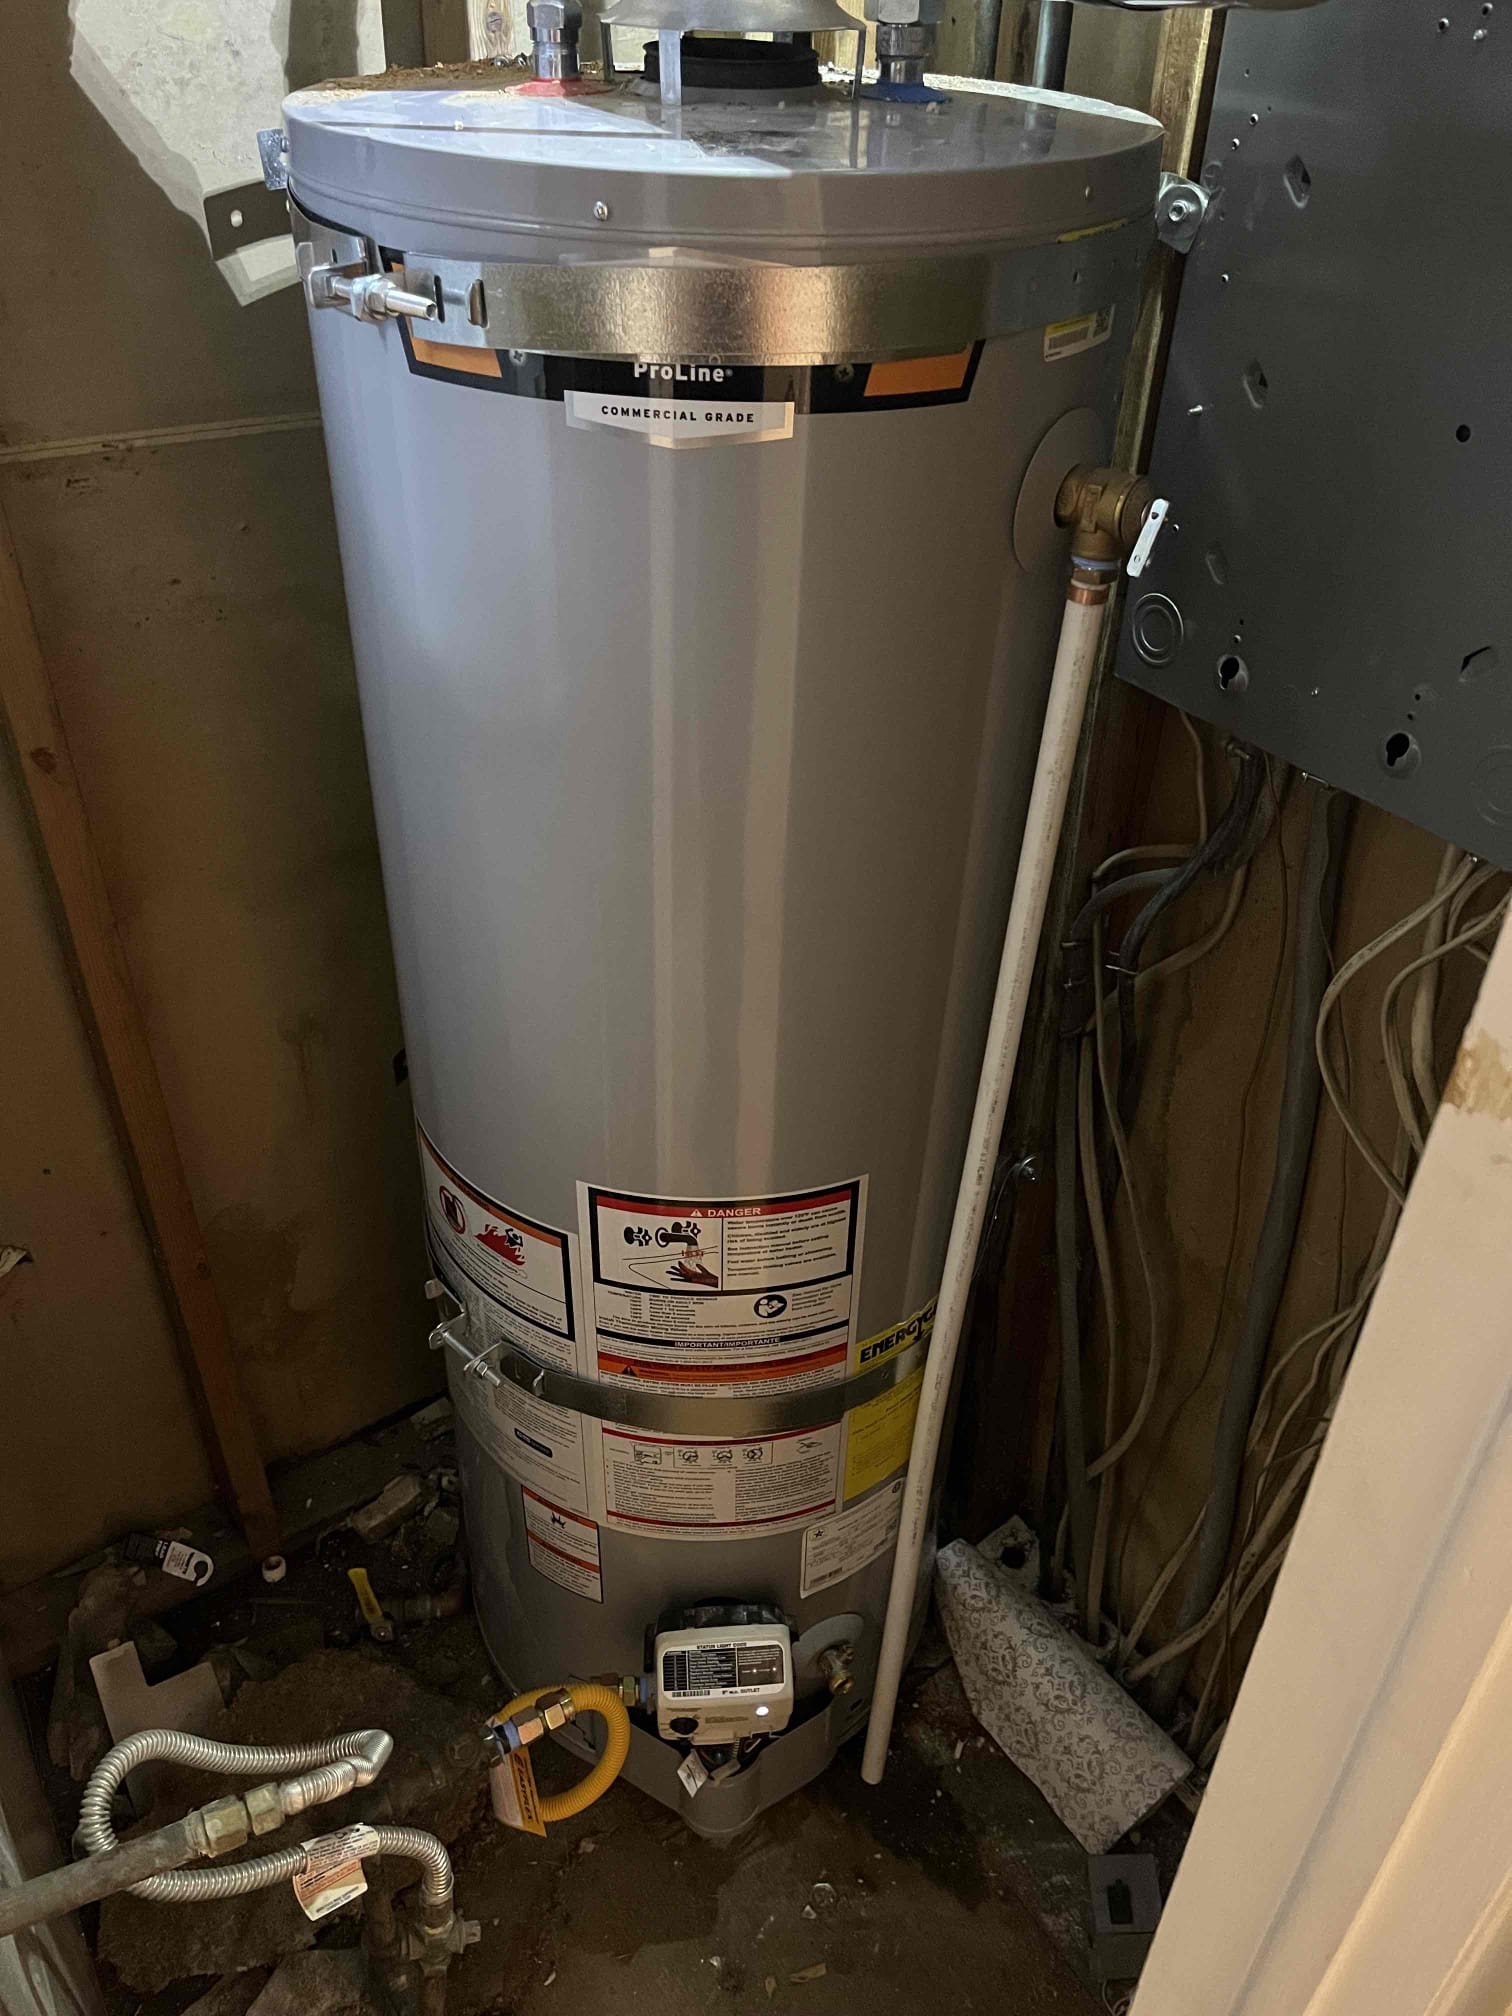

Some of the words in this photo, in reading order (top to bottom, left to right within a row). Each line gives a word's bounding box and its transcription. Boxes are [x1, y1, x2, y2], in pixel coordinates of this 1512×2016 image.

[601, 405, 697, 421] COMMERCIAL
[705, 412, 754, 423] GRADE
[707, 1207, 761, 1217] DANGER
[674, 1337, 780, 1348] IMPORTANT/IMPORTANTE
